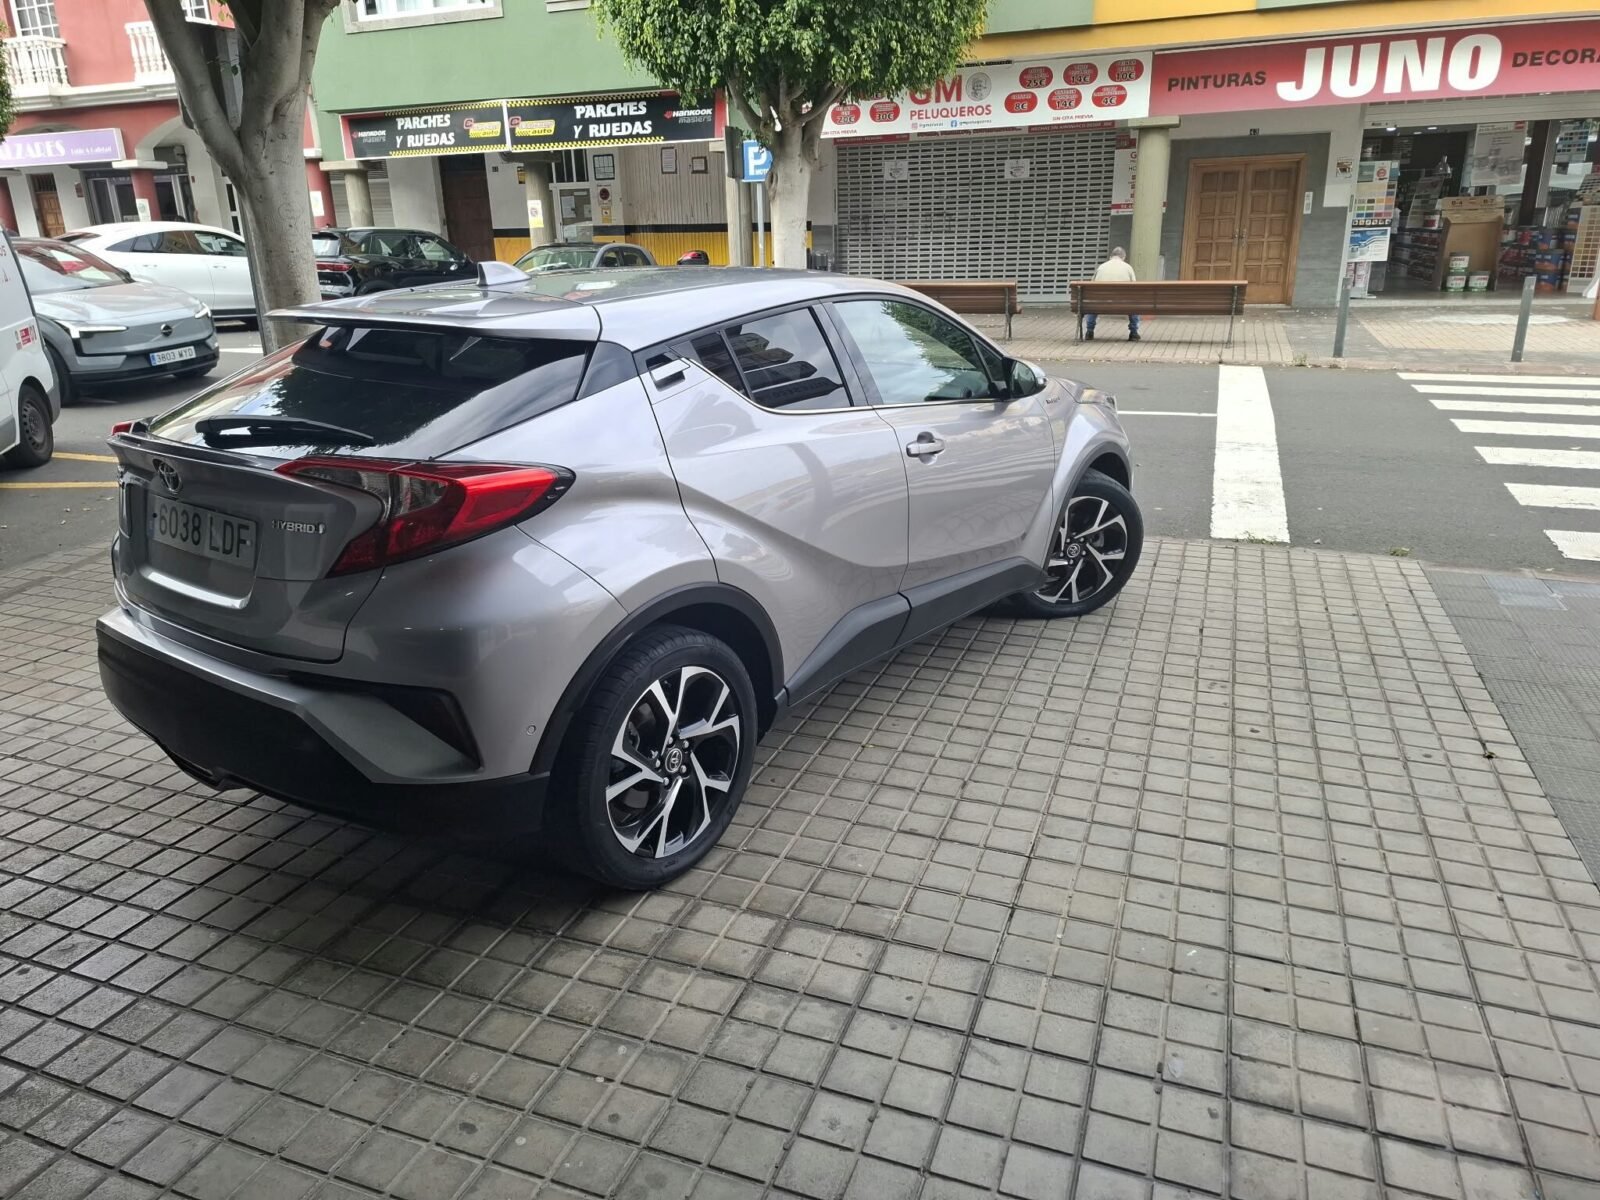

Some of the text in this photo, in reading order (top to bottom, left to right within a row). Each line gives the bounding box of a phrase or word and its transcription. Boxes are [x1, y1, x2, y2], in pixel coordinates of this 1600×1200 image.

[1168, 33, 1600, 102] PINTURAS JUNO DECOR
[1026, 79, 1045, 88] 25€
[1071, 74, 1089, 84] 14€
[1115, 72, 1135, 80] 10€
[1014, 103, 1028, 111] 8€
[1056, 100, 1075, 109] 14€
[1102, 97, 1116, 105] 4€
[574, 101, 647, 119] PARCHES
[876, 112, 894, 121] 30€
[910, 104, 992, 121] PELUQUEROS
[396, 114, 451, 130] PARCHES
[573, 121, 652, 139] Y RUEDAS
[396, 132, 455, 148] Y RUEDAS
[748, 146, 768, 176] P
[155, 351, 177, 363] 3803
[158, 503, 250, 558] 6038 LDF
[272, 519, 316, 534] HYBRID
